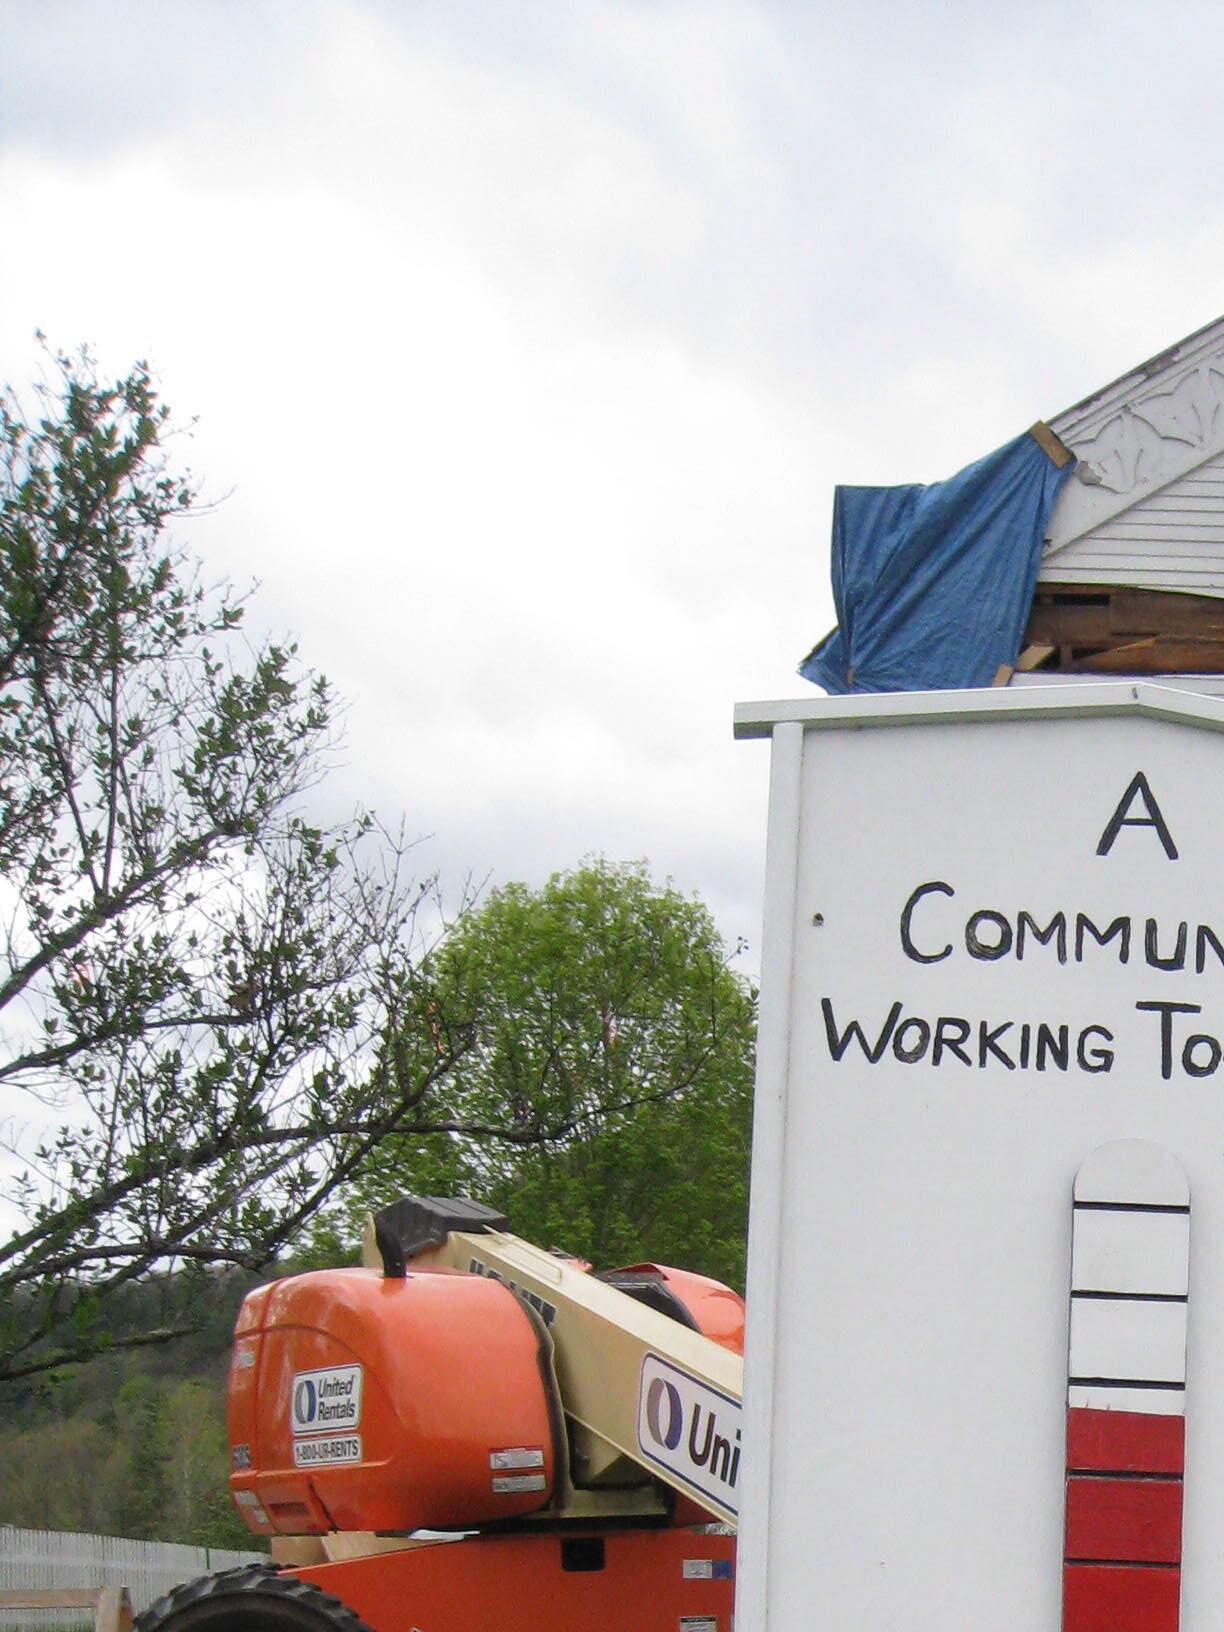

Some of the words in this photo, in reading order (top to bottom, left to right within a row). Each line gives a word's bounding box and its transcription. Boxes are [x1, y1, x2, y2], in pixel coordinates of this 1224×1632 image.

[1095, 771, 1179, 861] A
[821, 997, 1115, 1074] WORKING
[318, 1375, 354, 1398] United
[318, 1398, 356, 1421] Rentals
